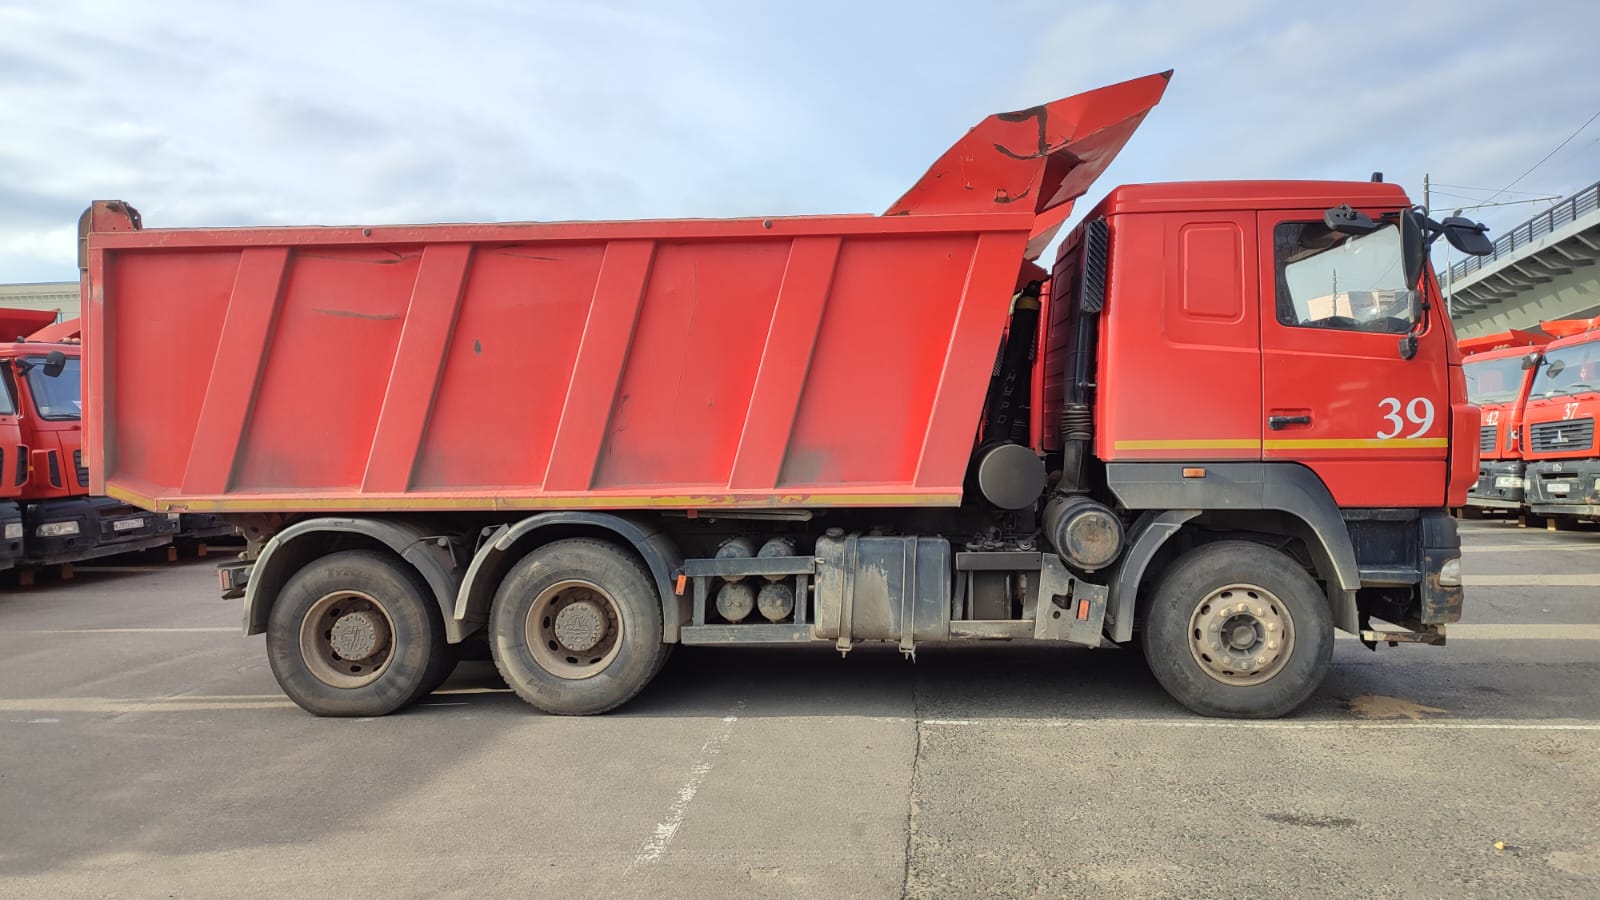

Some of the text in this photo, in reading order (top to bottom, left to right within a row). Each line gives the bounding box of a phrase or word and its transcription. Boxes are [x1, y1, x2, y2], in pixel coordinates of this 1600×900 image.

[1376, 397, 1435, 440] 39
[1486, 410, 1499, 426] 42
[1563, 402, 1579, 420] 37
